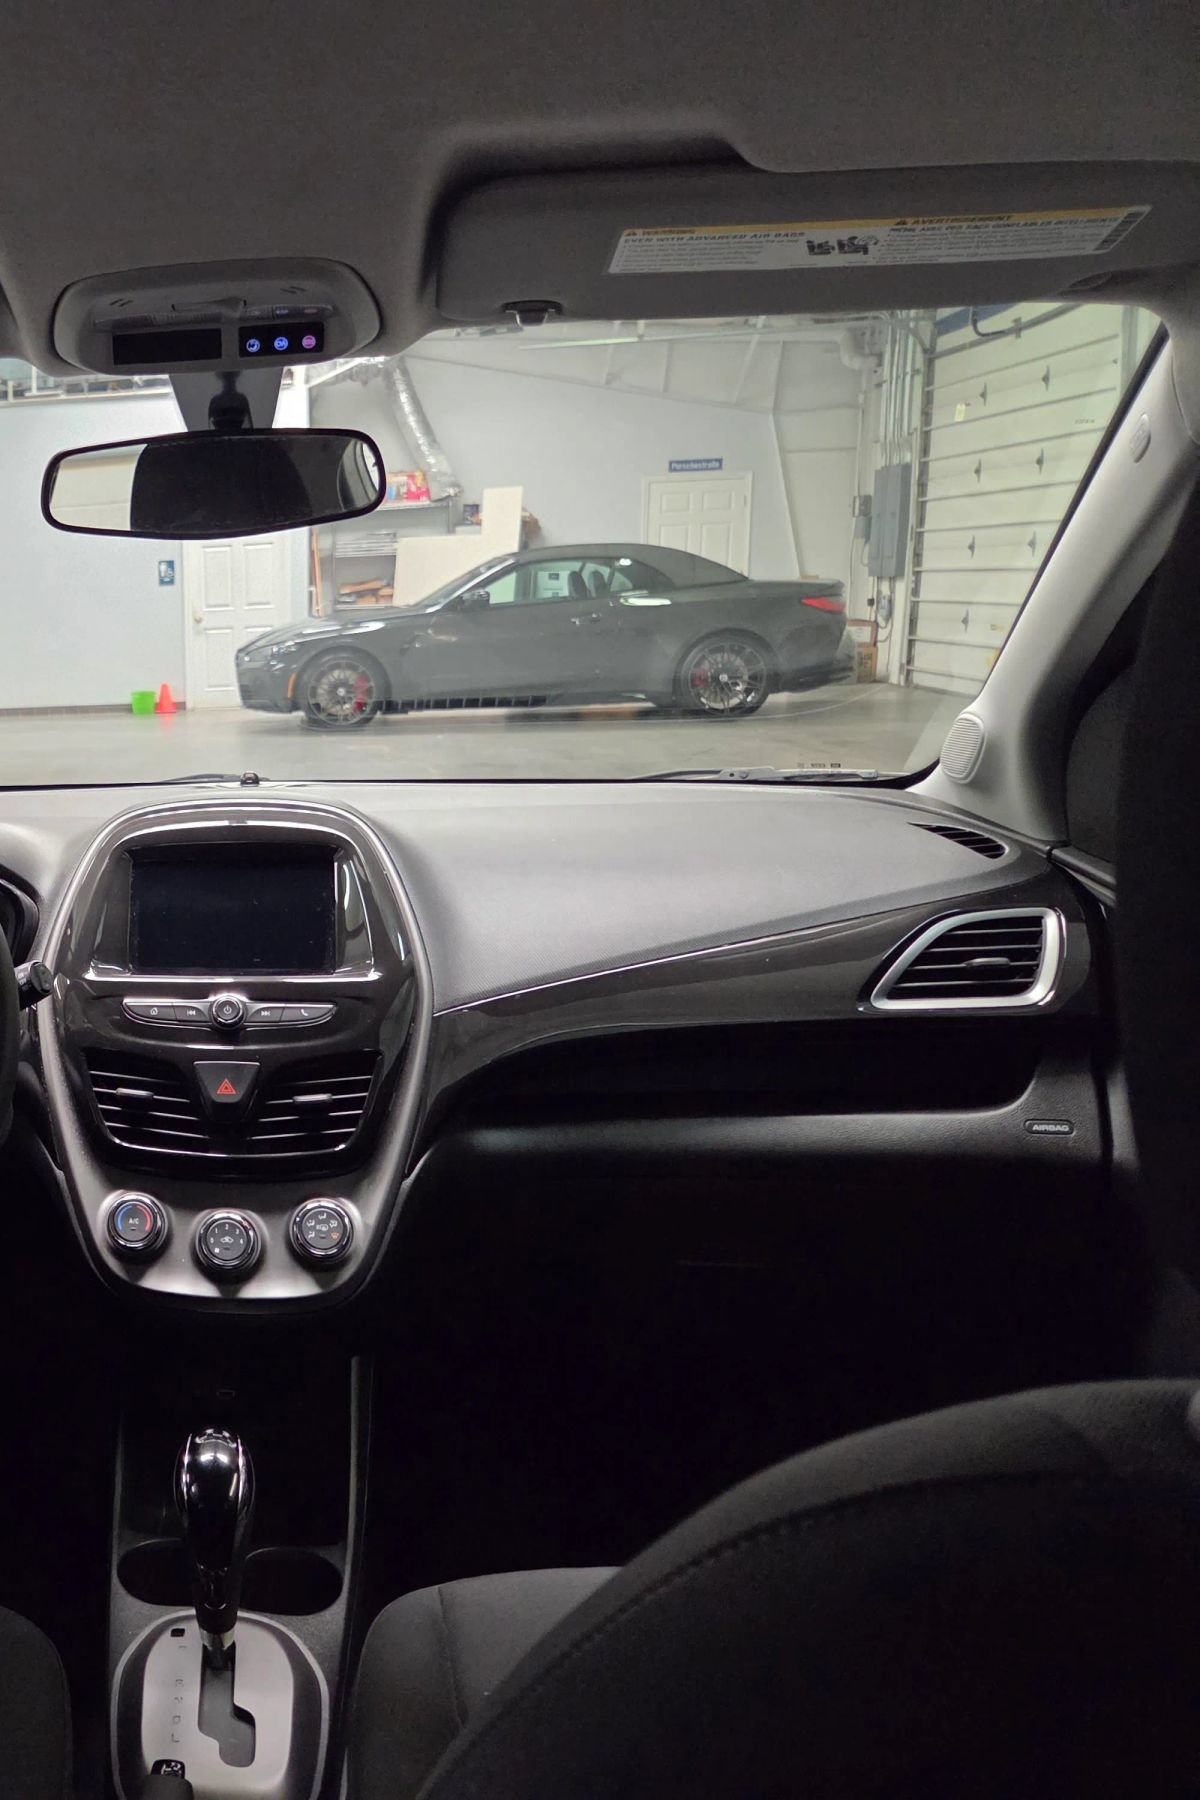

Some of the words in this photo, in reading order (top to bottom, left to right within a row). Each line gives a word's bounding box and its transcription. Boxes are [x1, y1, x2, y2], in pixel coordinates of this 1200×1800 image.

[1032, 1124, 1069, 1132] AIRBAG
[128, 1217, 139, 1225] A/C
[171, 1732, 180, 1743] L
